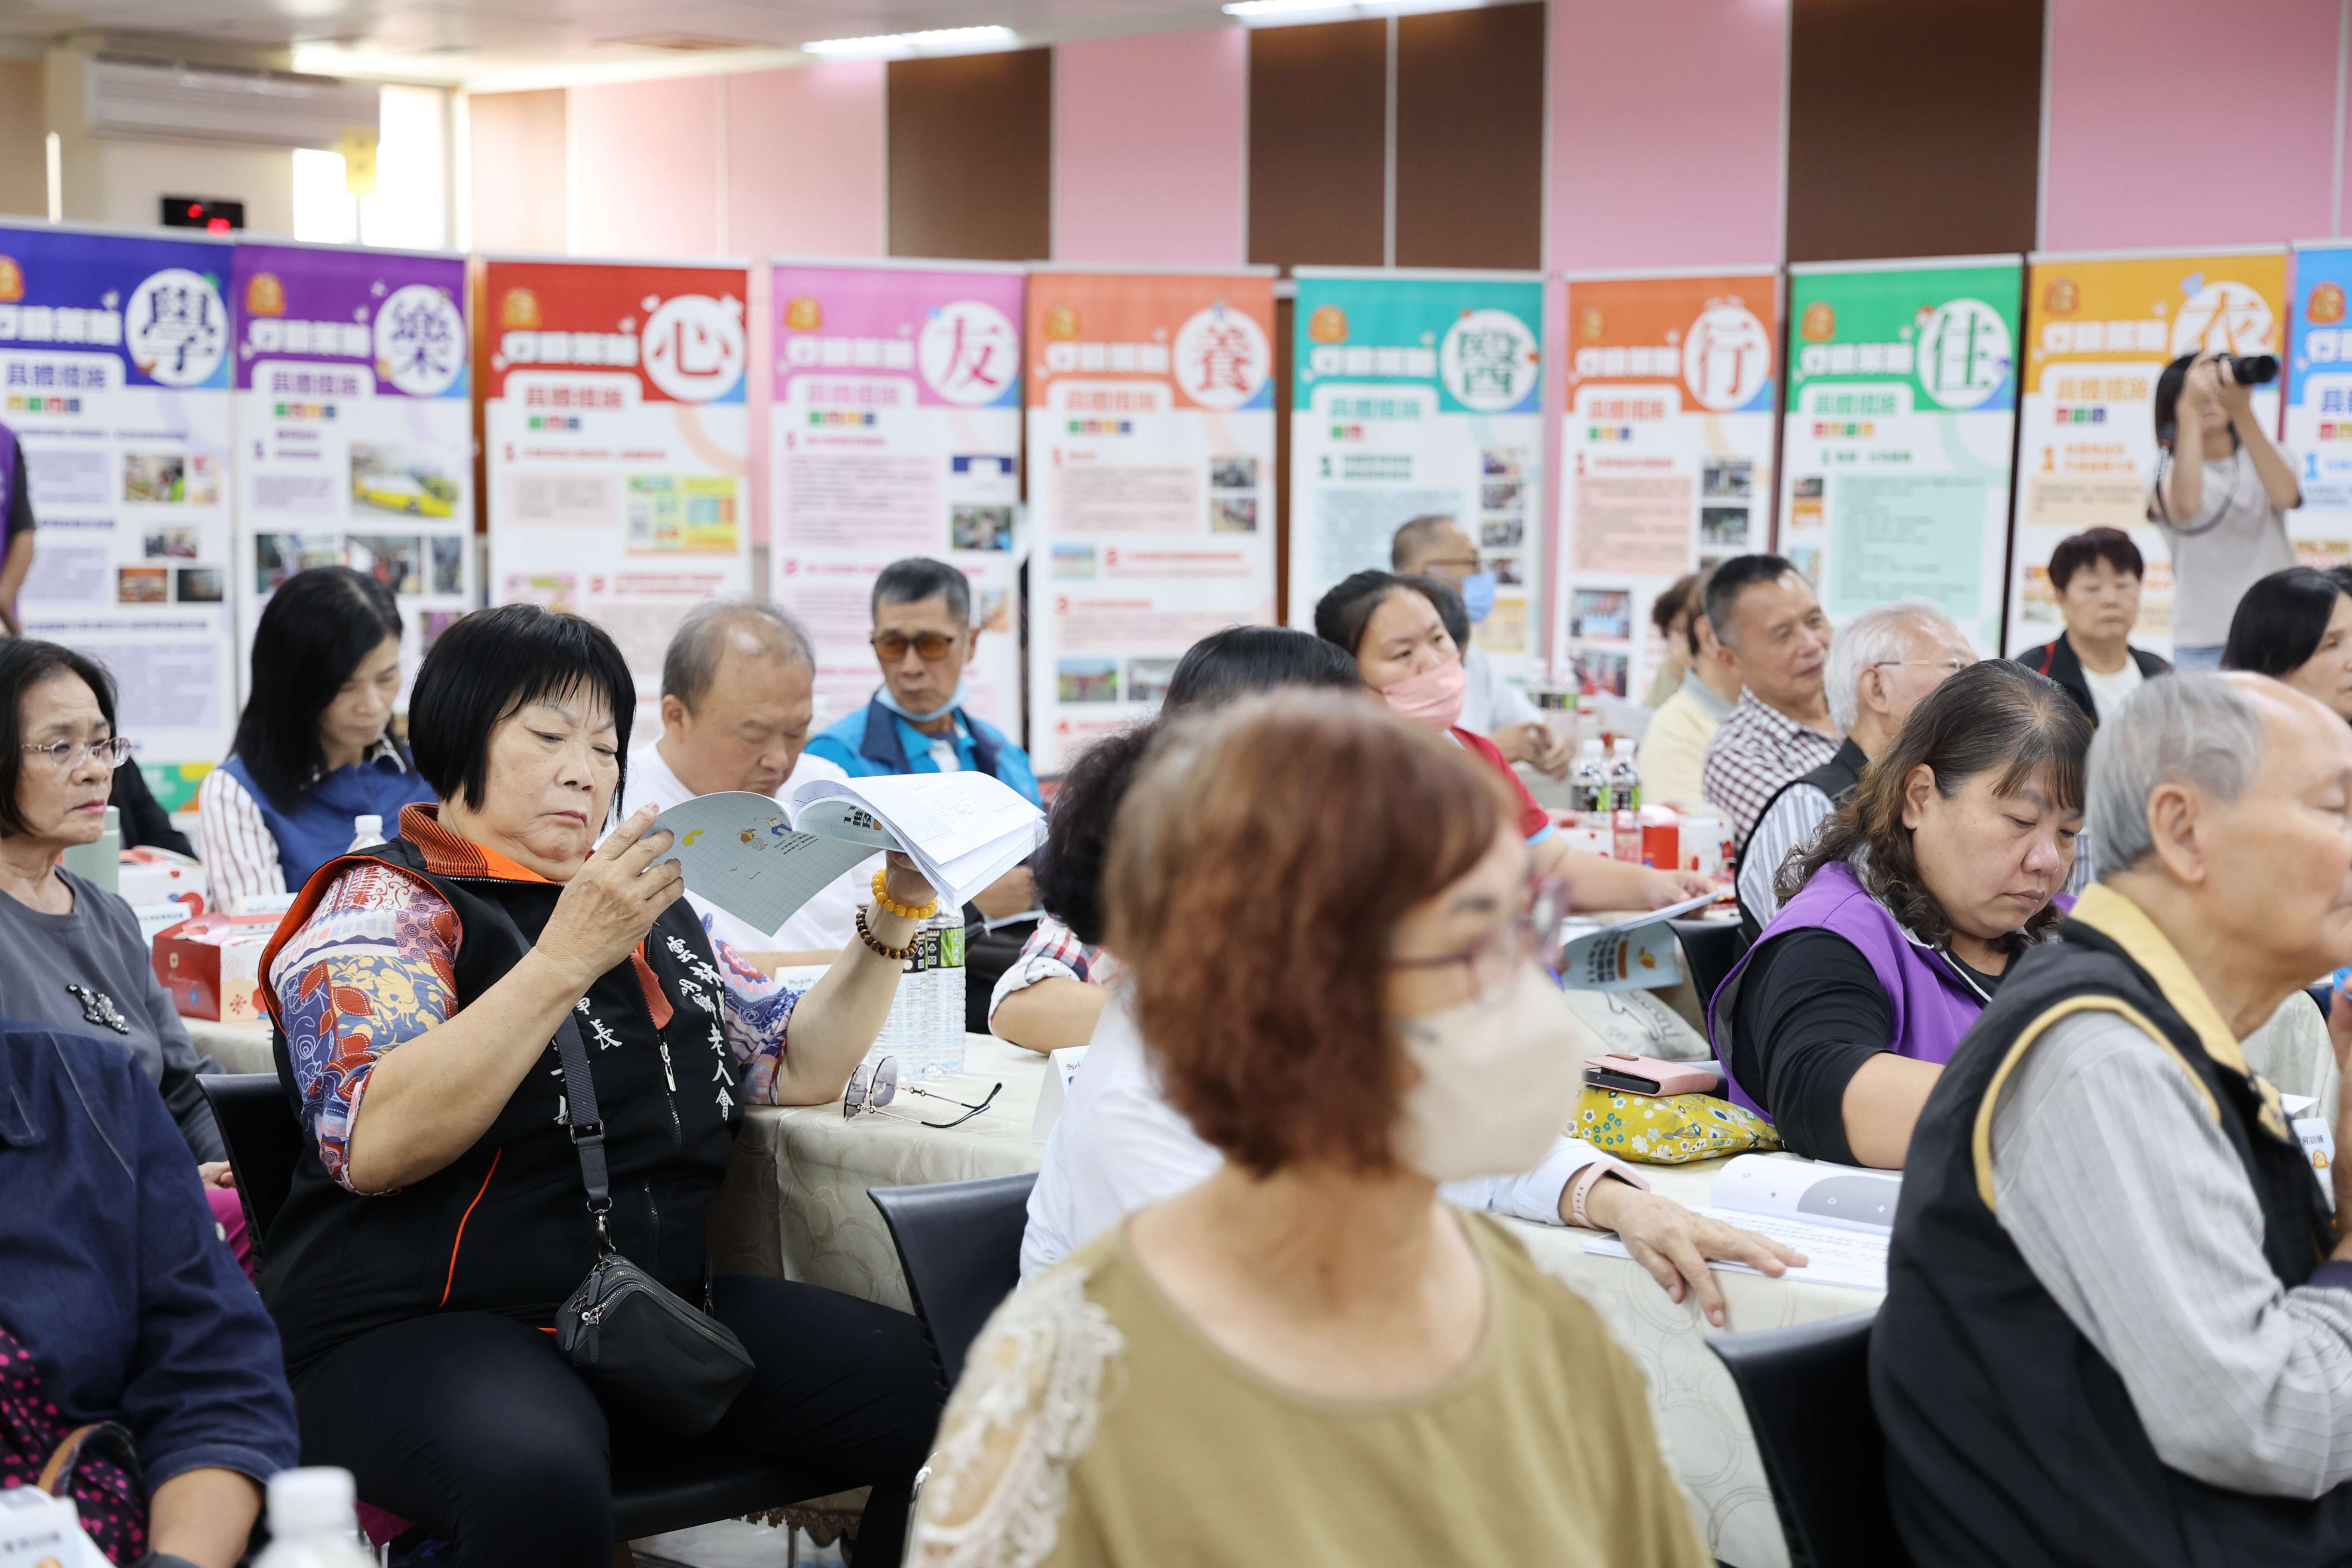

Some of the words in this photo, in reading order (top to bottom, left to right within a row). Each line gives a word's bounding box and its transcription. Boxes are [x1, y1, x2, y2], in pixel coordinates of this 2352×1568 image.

[143, 287, 216, 373] 學
[389, 298, 451, 378] 樂
[655, 320, 732, 377] 心
[933, 316, 1001, 389] 友
[1196, 325, 1253, 396] 養
[1457, 329, 1522, 398] 醫
[1699, 319, 1755, 401] 行
[1930, 310, 1994, 393] 住
